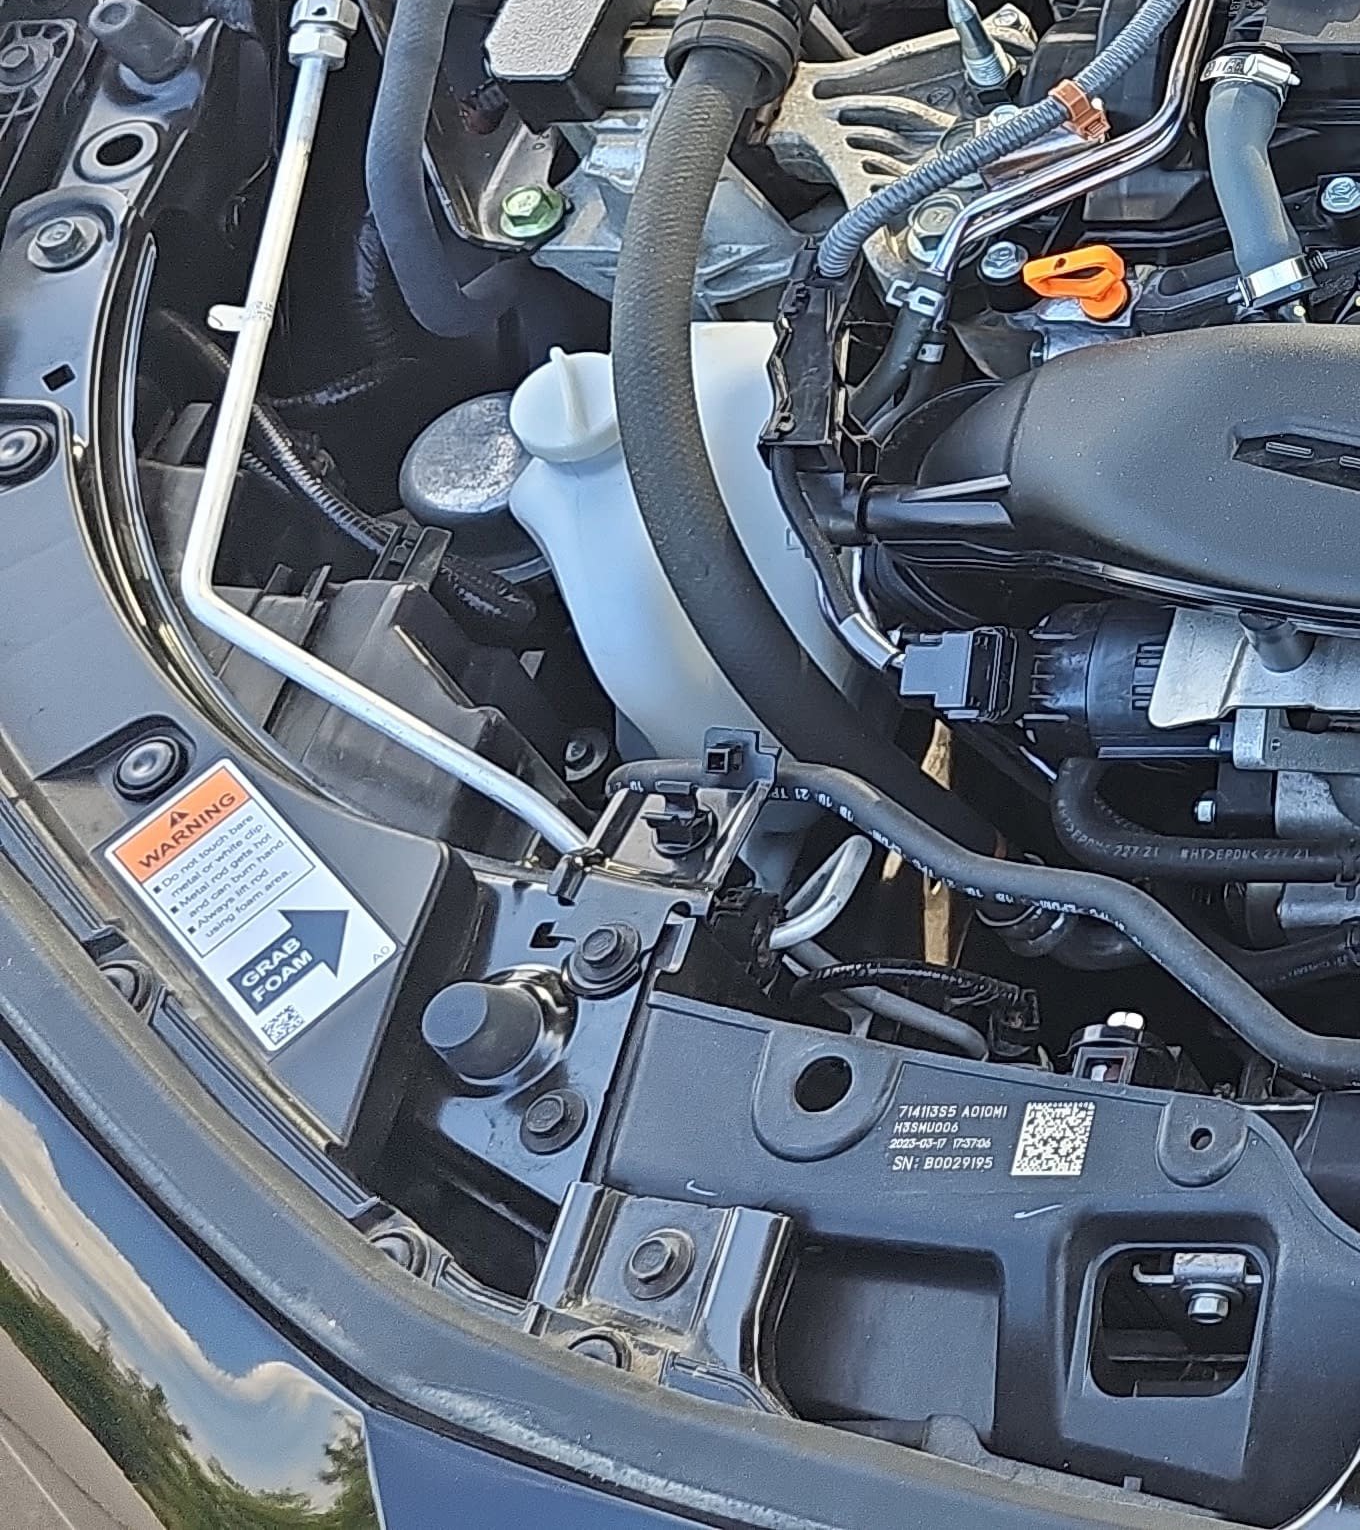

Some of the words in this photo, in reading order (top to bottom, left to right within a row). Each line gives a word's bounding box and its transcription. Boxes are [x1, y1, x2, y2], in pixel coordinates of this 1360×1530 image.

[138, 792, 236, 868] WARNING
[162, 872, 179, 888] Do
[180, 857, 198, 874] not
[200, 834, 228, 859] touch
[229, 815, 254, 835] bare
[171, 871, 202, 898] metal
[203, 861, 214, 873] or
[215, 840, 244, 863] white
[179, 881, 210, 907] Metal
[211, 869, 229, 883] rod
[230, 850, 254, 869] gets
[254, 833, 272, 849] hot
[189, 899, 210, 918] and
[211, 884, 231, 900] can
[230, 863, 256, 882] burn
[198, 897, 236, 928] Always
[236, 884, 250, 897] lift
[251, 869, 269, 885] rod
[206, 914, 236, 938] using
[236, 890, 264, 913] foam
[241, 937, 302, 987] GRAB
[251, 949, 313, 1003] FOAM
[888, 1138, 947, 1150] 2023-03-17
[892, 1155, 920, 1170] SN:
[923, 1156, 993, 1170] B0029195
